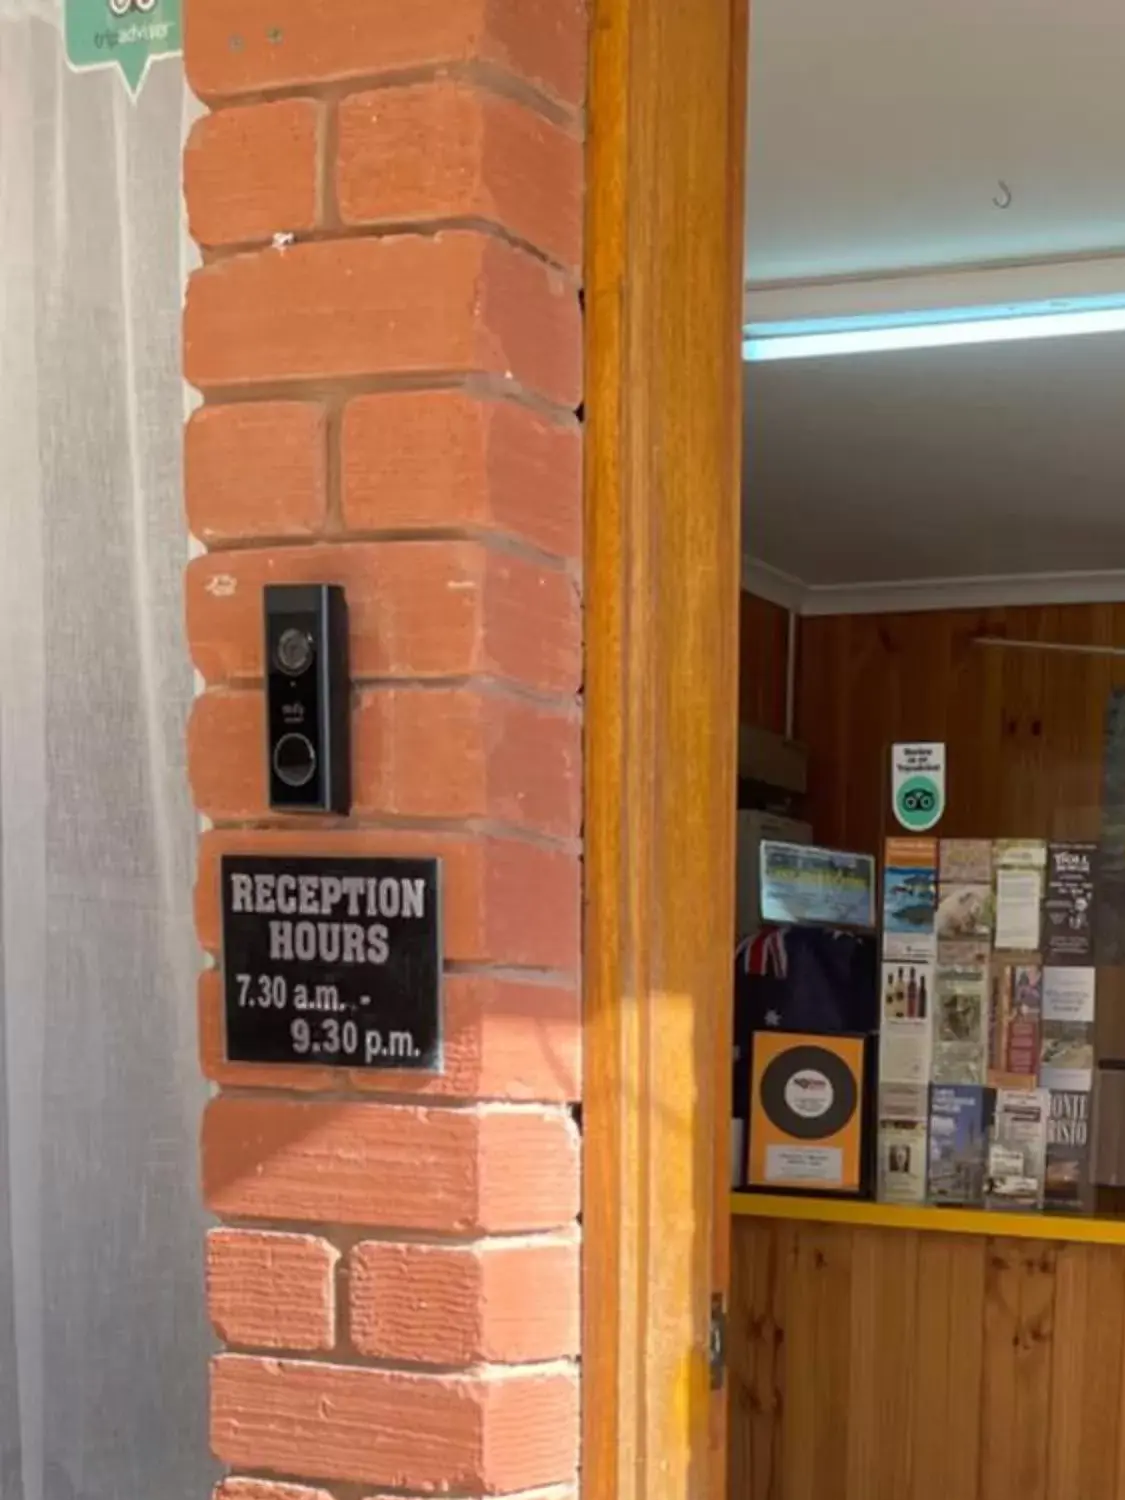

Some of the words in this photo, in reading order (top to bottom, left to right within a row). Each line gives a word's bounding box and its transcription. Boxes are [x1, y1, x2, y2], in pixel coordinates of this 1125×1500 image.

[230, 872, 426, 918] RECEPTION
[268, 920, 390, 964] HOURS
[236, 973, 287, 1009] 7.30
[293, 983, 346, 1012] a.m.
[290, 1018, 358, 1054] 9.30
[365, 1029, 422, 1064] p.m.
